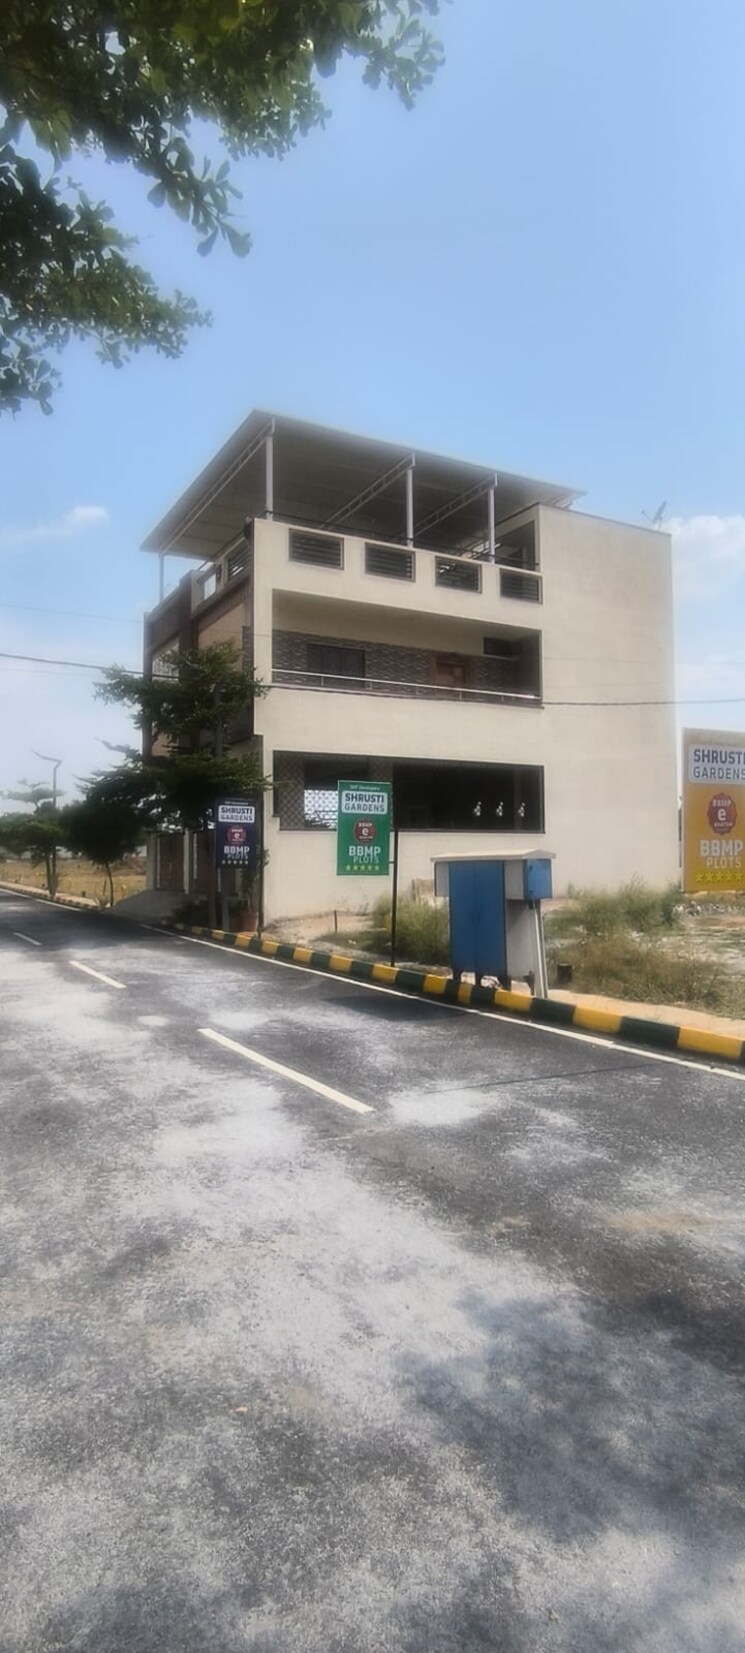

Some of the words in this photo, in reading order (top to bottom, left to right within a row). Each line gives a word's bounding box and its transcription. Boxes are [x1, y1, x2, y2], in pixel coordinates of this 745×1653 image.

[693, 766, 745, 780] GARDENS
[345, 793, 385, 803] SHRUSTI
[221, 807, 253, 815] SHRUSTI
[344, 802, 385, 812] GARDENS
[220, 813, 253, 821] GARDENS
[718, 808, 727, 821] e
[223, 845, 250, 854] BBMP
[348, 845, 382, 857] BBMP
[700, 839, 744, 857] BBMP
[353, 855, 379, 864] PLOTS
[706, 857, 742, 869] PLOTS
